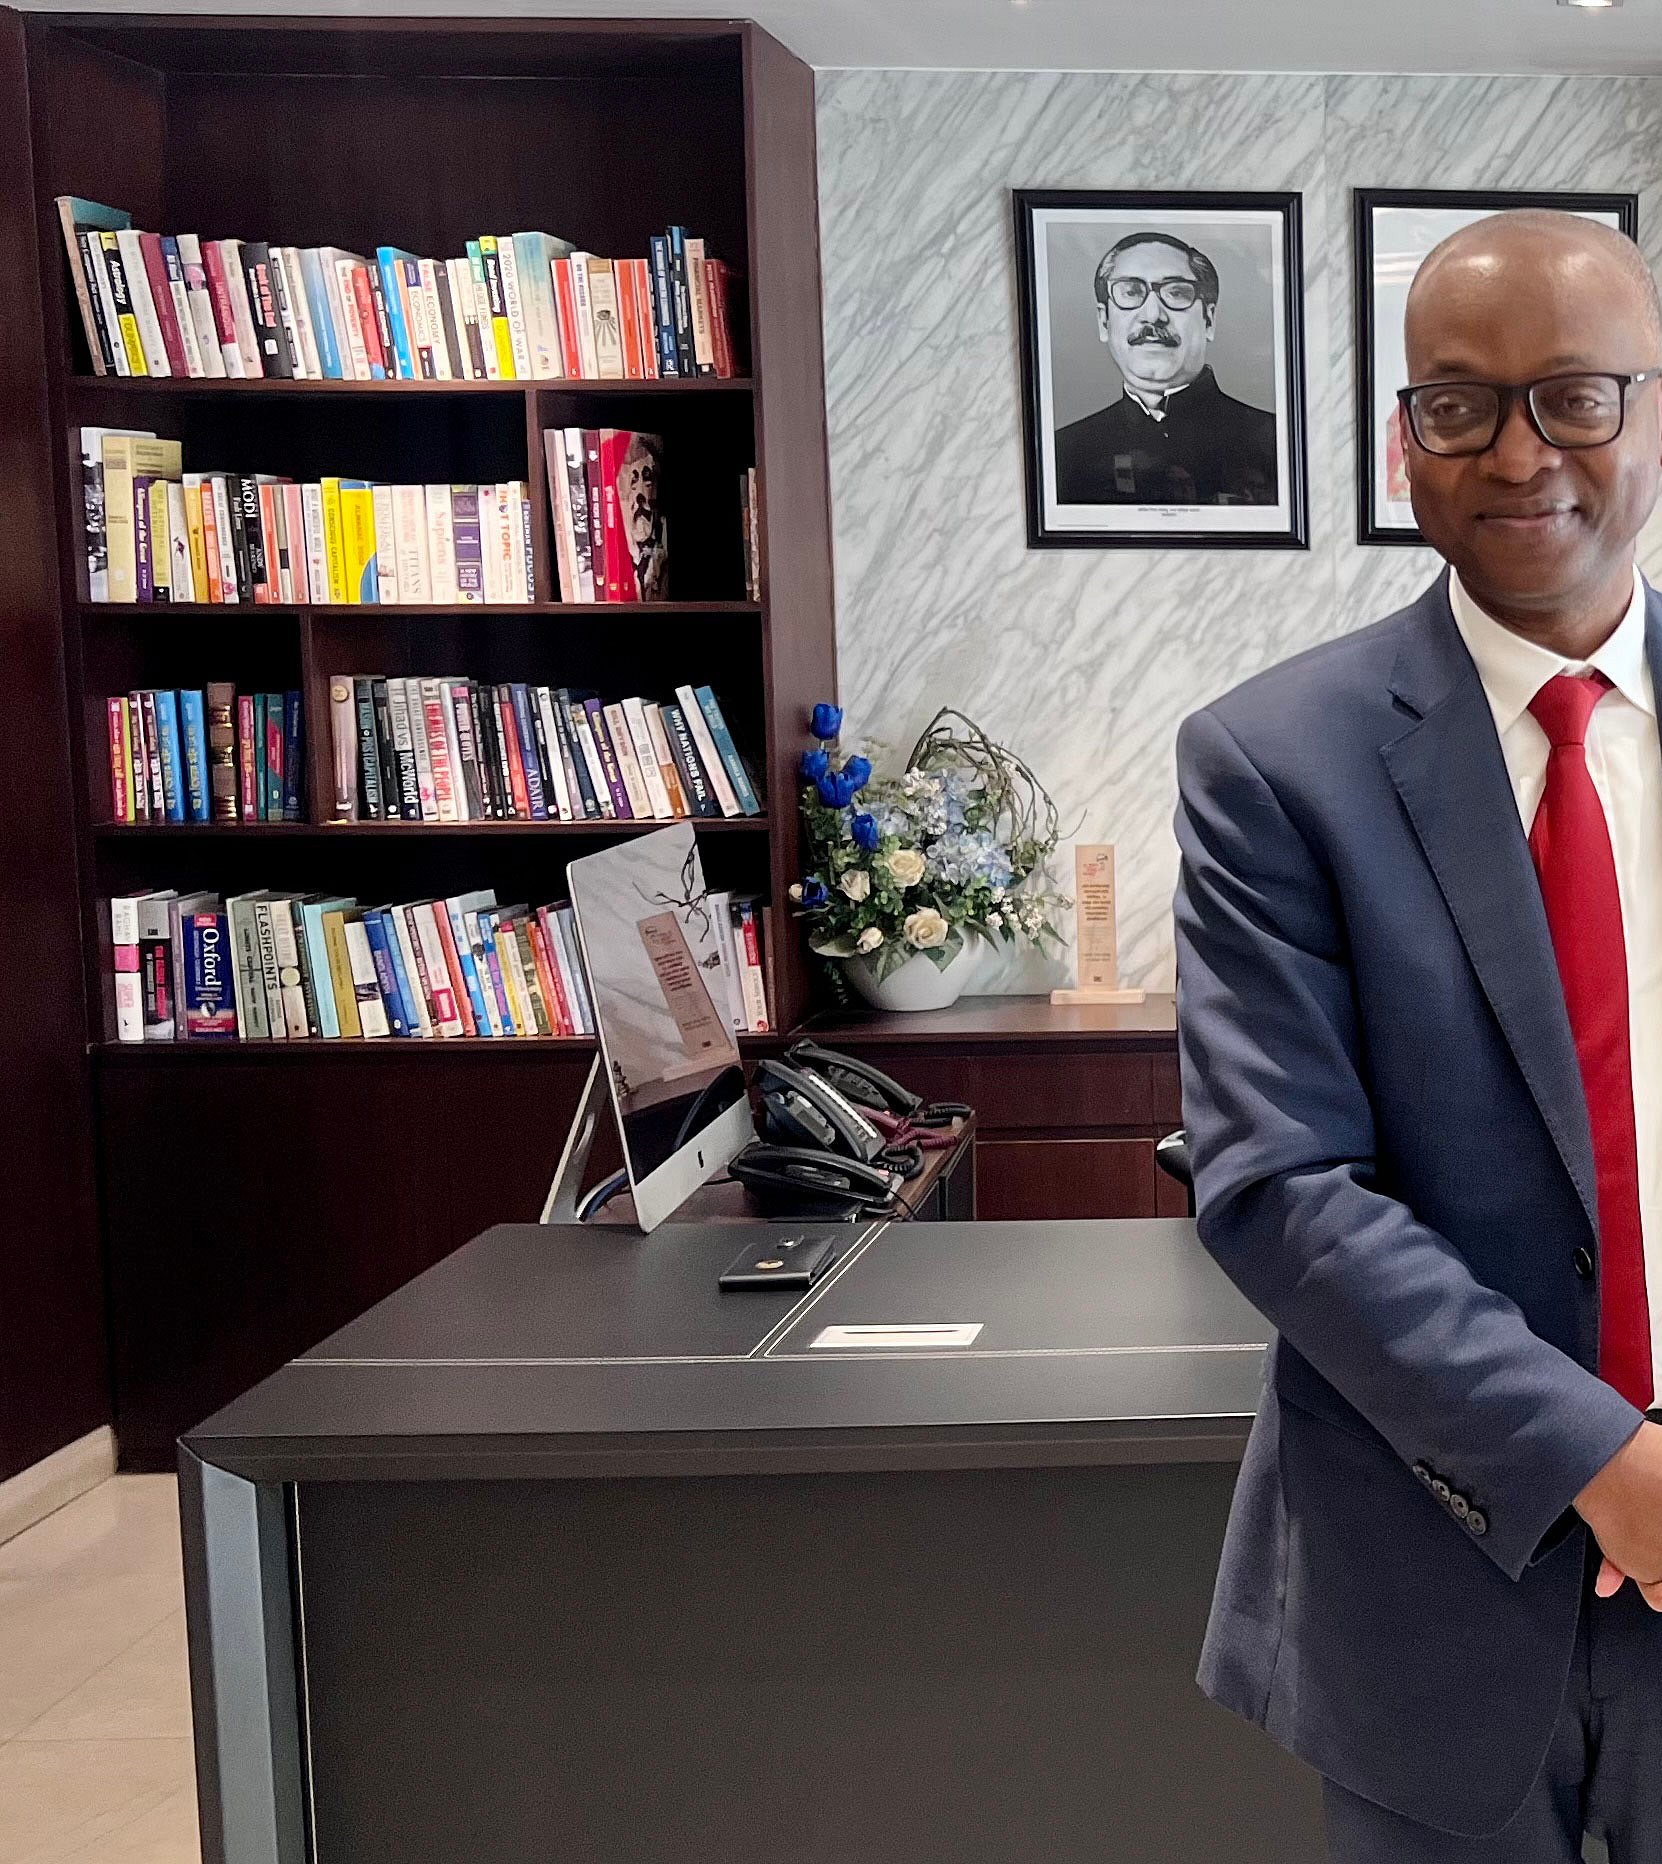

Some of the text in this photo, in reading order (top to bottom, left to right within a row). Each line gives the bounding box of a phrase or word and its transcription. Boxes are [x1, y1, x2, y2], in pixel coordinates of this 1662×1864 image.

[109, 260, 128, 305] Astrology
[423, 263, 441, 344] FALSE ECONOMY
[503, 253, 525, 360] 2020 WORLD OF WAR
[692, 257, 706, 334] FINANCIAL MARKETS
[348, 304, 358, 337] POVERTY
[411, 290, 426, 343] ECONOMICS
[241, 478, 258, 518] MODI
[328, 508, 340, 584] CONSCIOUS CAPITALISM
[433, 512, 447, 565] Sapiens
[502, 524, 512, 561] TOPIC
[409, 550, 421, 594] TITANS
[393, 699, 409, 729] Jihad
[362, 737, 377, 803] POSTCAPITALISM
[399, 752, 419, 803] McWorld
[433, 754, 449, 768] THE
[671, 709, 706, 802] WHY NATIONS FAIL
[437, 771, 452, 801] PEOPLE
[526, 768, 542, 810] ADAIR
[202, 928, 222, 986] Oxford
[256, 905, 278, 990] FLASHPOINTS
